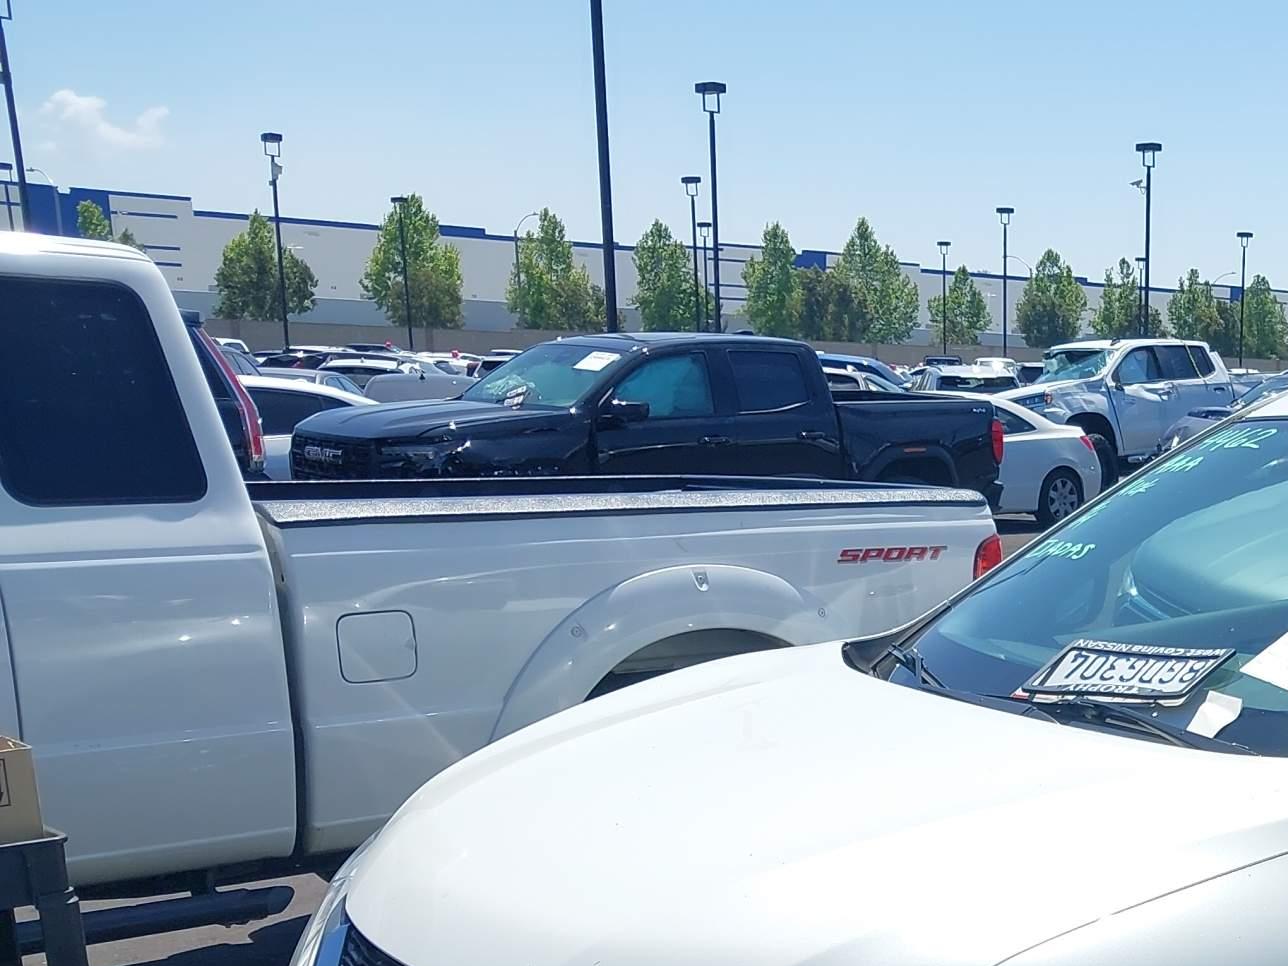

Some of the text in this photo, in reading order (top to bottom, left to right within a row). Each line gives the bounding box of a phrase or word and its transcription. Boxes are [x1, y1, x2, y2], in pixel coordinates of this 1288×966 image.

[837, 545, 948, 564] SPORT
[1074, 638, 1132, 652] NISSAN
[1062, 683, 1139, 694] TROPHY
